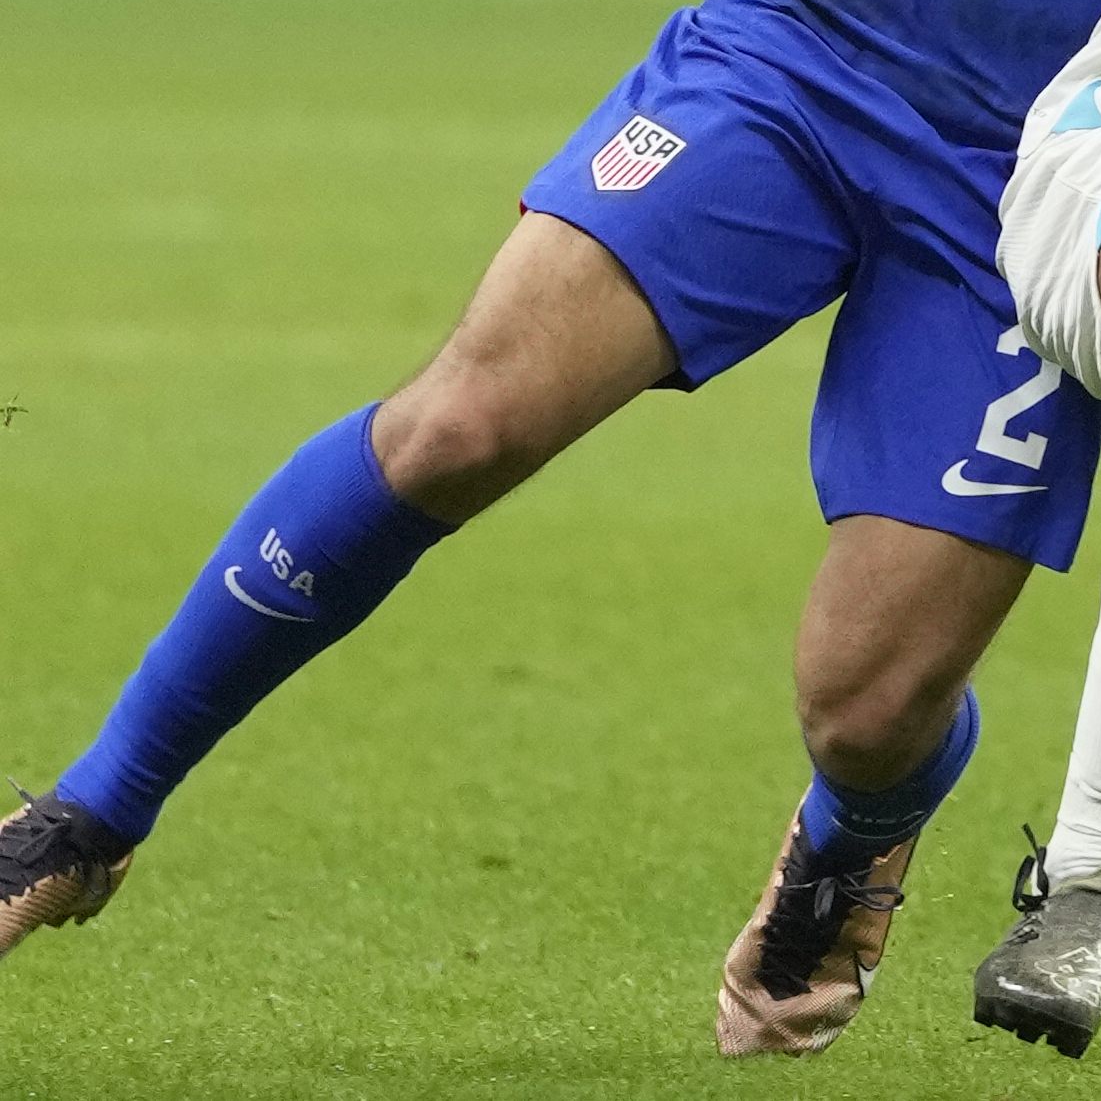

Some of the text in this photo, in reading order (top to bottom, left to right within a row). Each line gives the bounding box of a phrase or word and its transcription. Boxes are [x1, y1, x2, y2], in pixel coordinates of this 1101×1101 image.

[625, 120, 679, 159] USA
[975, 323, 1063, 470] 2
[260, 527, 315, 597] USA
